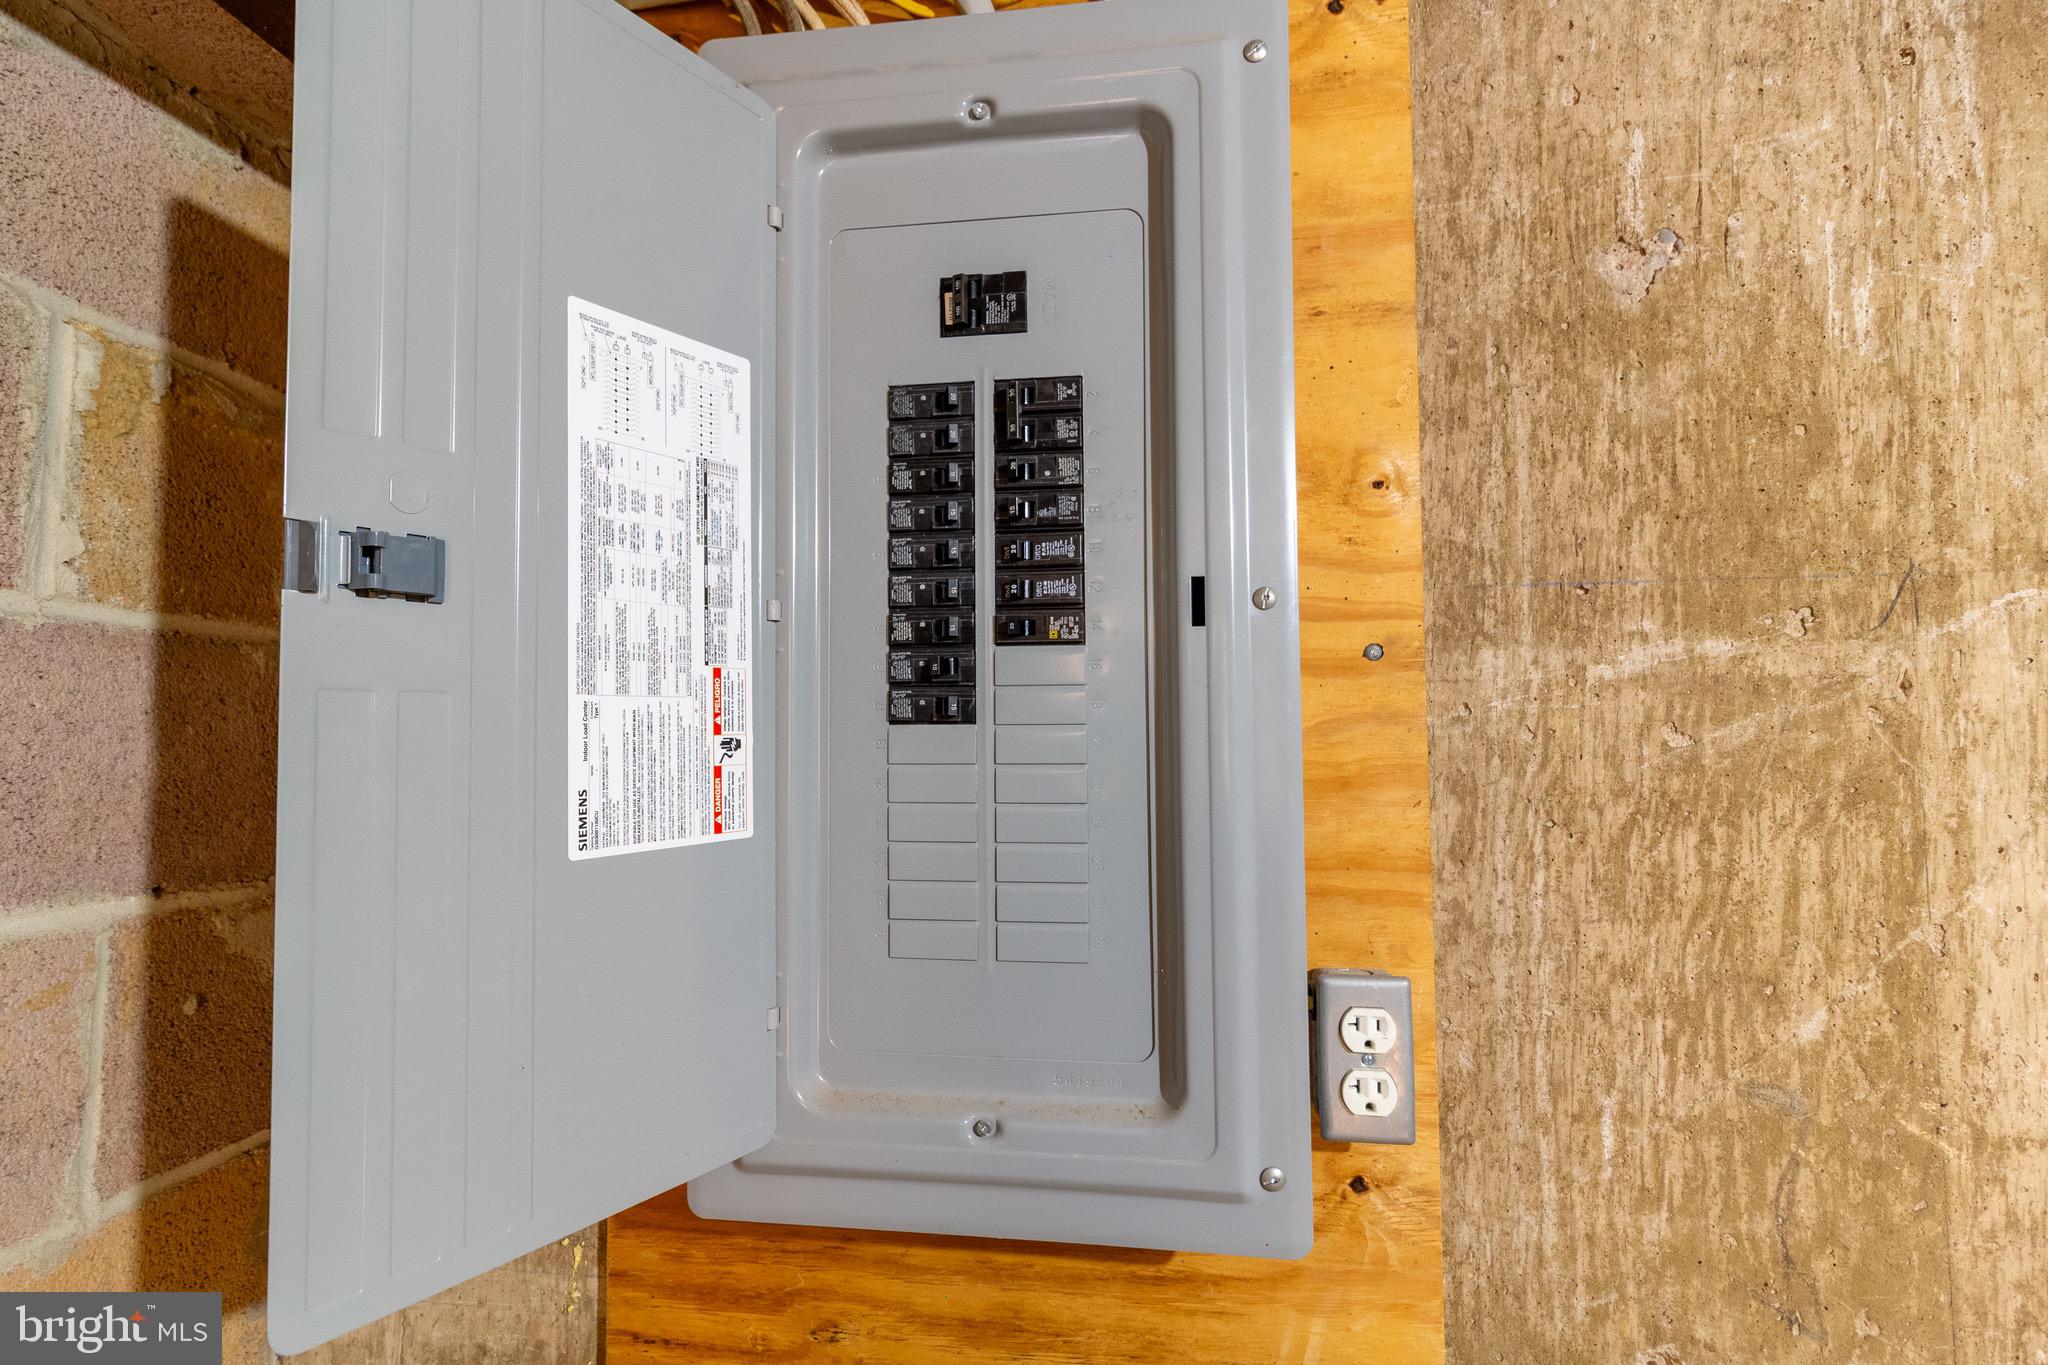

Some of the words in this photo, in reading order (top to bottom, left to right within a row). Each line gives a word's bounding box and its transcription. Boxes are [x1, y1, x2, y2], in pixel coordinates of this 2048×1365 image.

[950, 430, 956, 438] 20
[1010, 506, 1015, 514] 15
[1011, 545, 1016, 553] 20
[1011, 585, 1016, 593] 20
[578, 789, 587, 851] SIEMENS
